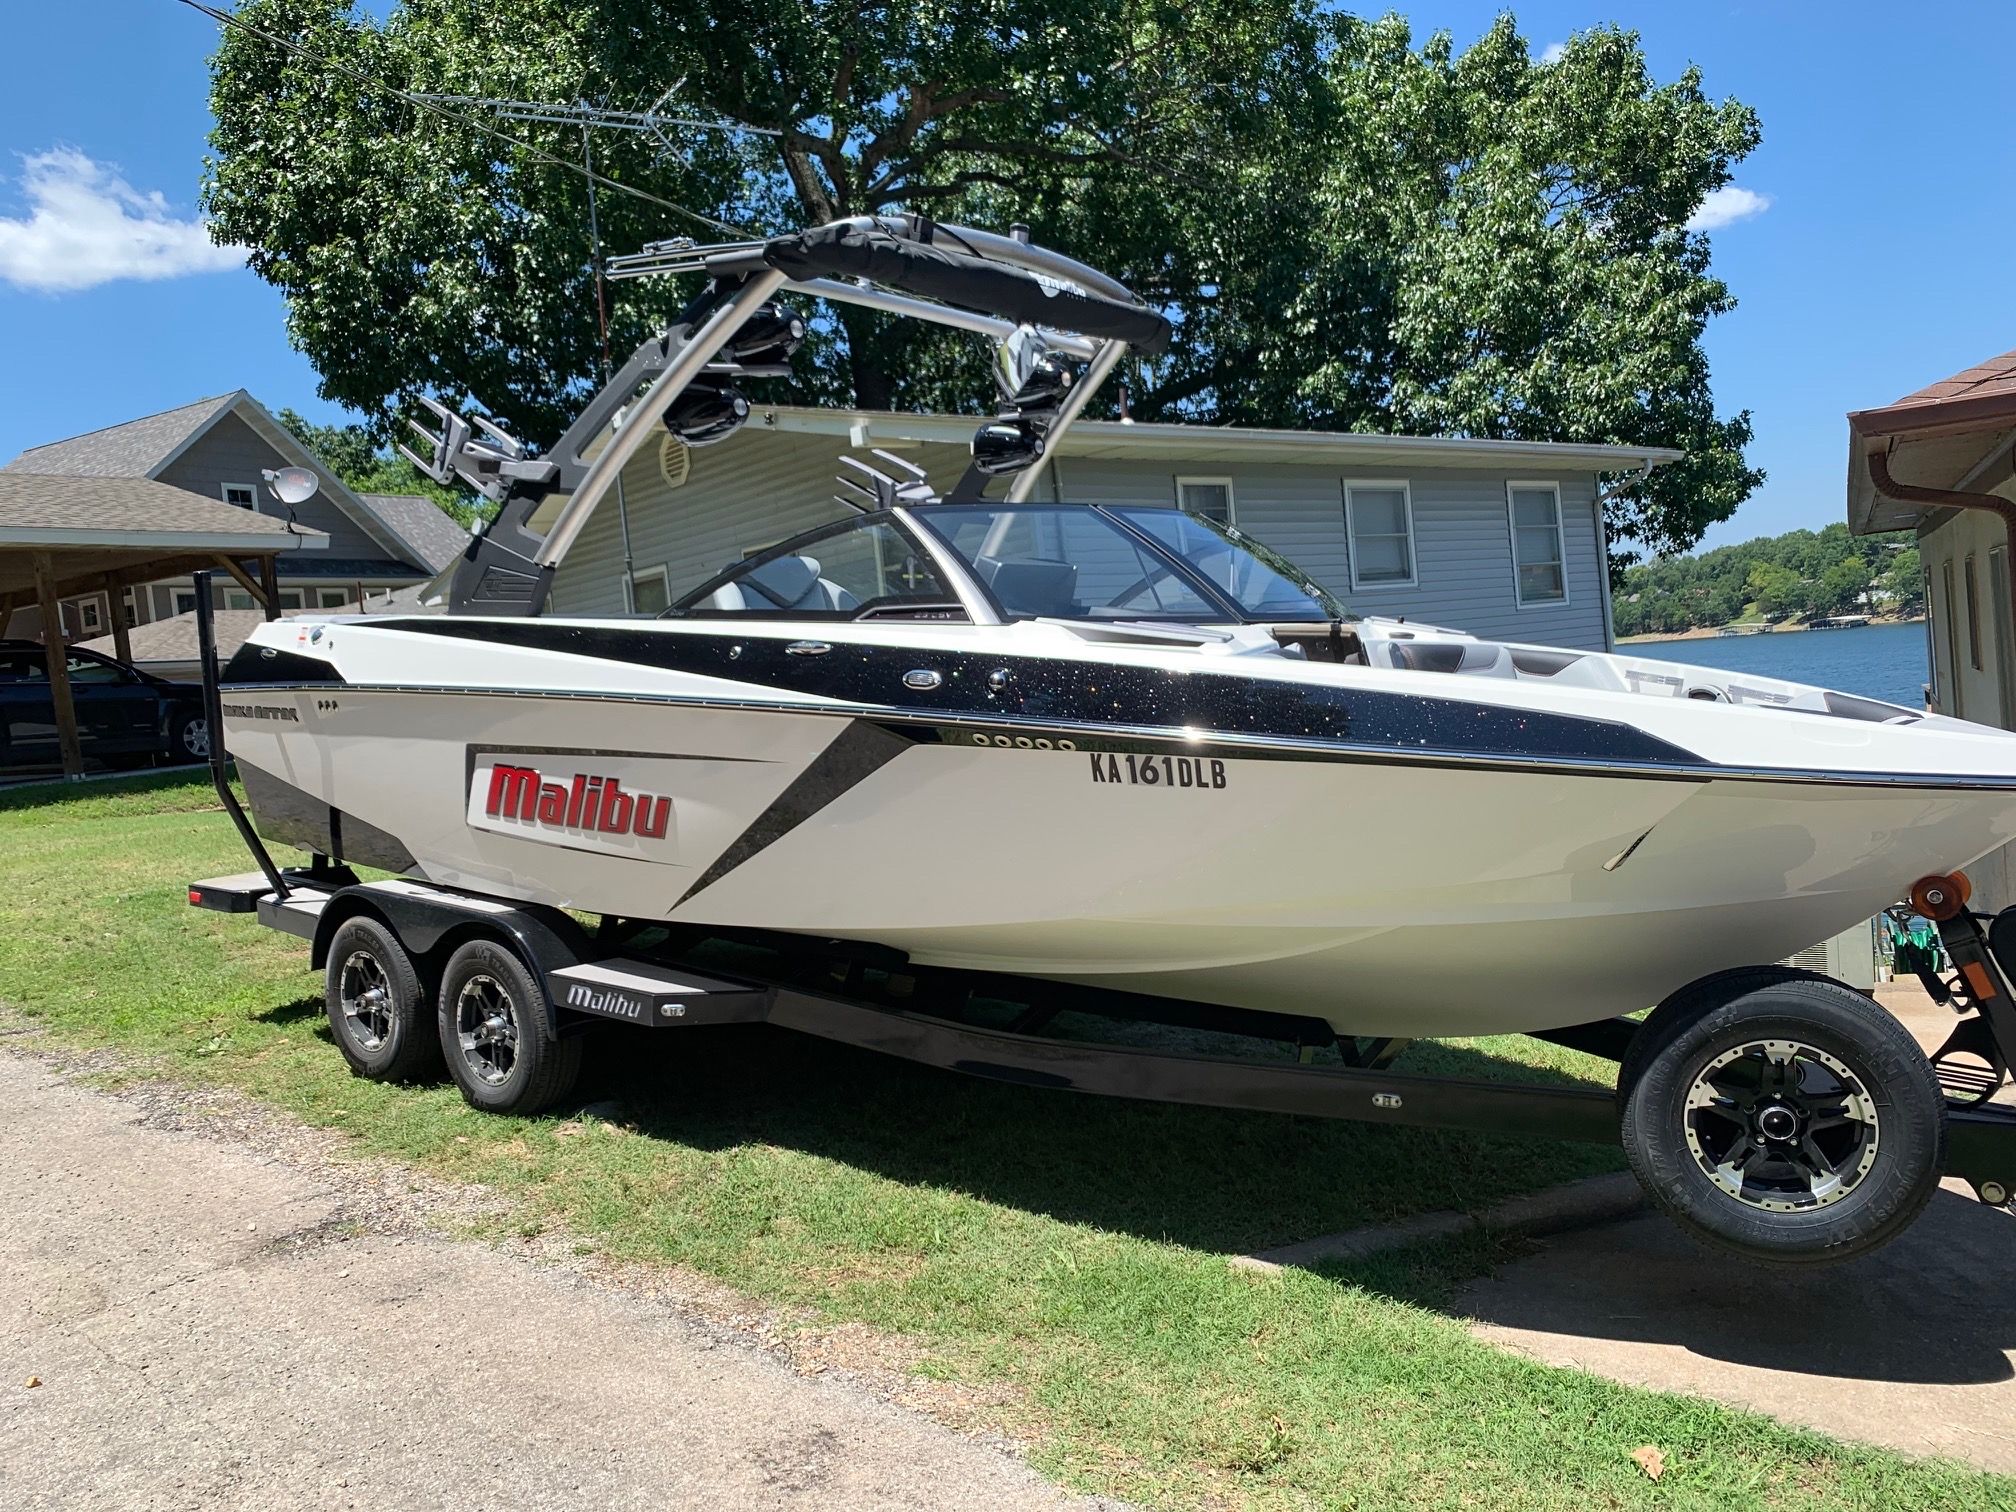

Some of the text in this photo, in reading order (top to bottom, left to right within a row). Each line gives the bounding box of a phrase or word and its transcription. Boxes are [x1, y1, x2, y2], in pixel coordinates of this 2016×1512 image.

[1090, 752, 1227, 789] KA161DLB
[486, 763, 672, 839] Malibu
[566, 984, 642, 1018] Malibu
